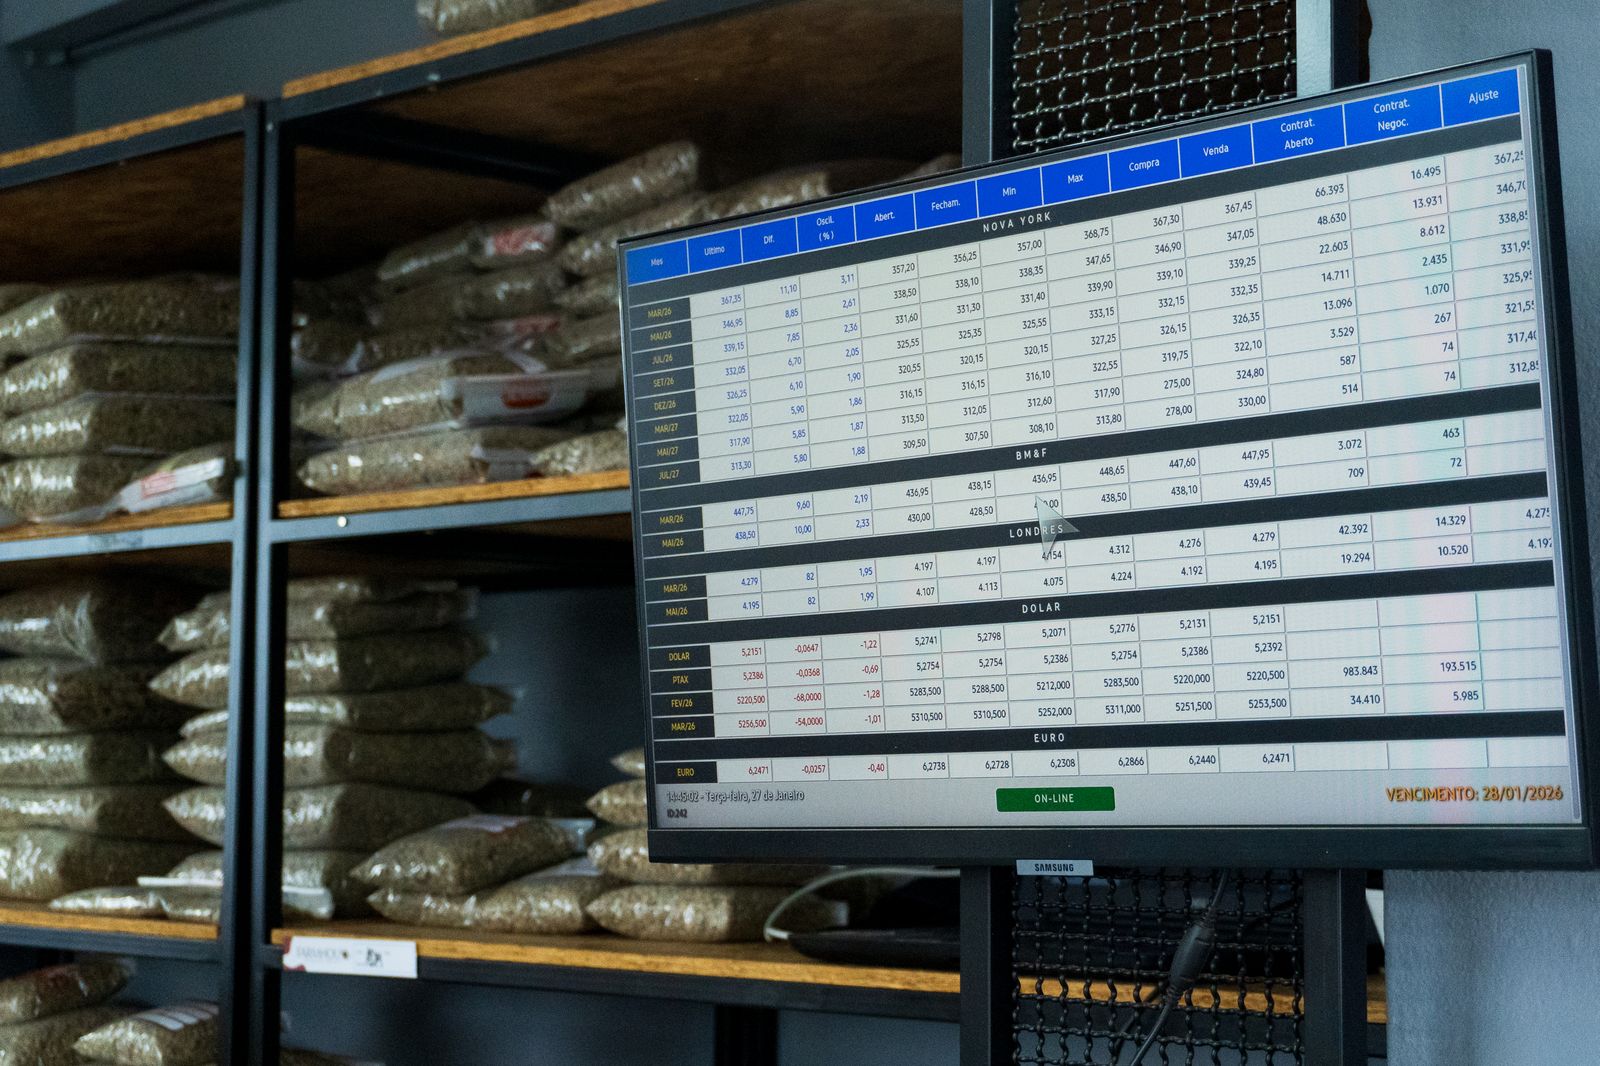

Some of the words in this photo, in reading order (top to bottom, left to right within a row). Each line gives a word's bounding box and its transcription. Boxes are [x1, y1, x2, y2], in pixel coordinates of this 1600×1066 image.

[1468, 89, 1499, 104] Ajuste
[1373, 98, 1410, 114] Contrat.
[1280, 118, 1315, 132] Contrat.
[1377, 118, 1409, 131] Negoc.
[1202, 144, 1229, 156] Venda
[1284, 136, 1314, 150] Aberto
[1128, 158, 1160, 172] Compra
[1067, 174, 1084, 184] Max
[1002, 186, 1017, 197] Min
[931, 199, 960, 211] Fecham.
[874, 211, 895, 222] Abert.
[982, 218, 1014, 232] NOVA
[1019, 211, 1051, 225] YORK
[647, 306, 672, 318] MAR/26
[720, 293, 742, 306] 367,35
[953, 250, 977, 263] 356,25
[1084, 226, 1109, 240] 368,75
[1152, 213, 1180, 227] 367,30
[1314, 183, 1345, 197] 66.393
[1411, 165, 1441, 179] 16.495
[763, 234, 774, 244] Dif.
[649, 330, 672, 341] MAI/26
[842, 297, 856, 309] 2,61
[893, 287, 917, 300] 338,50
[1018, 264, 1044, 278] 338,35
[1226, 227, 1254, 242] 347,05
[1412, 194, 1442, 209] 13.931
[652, 353, 673, 364] JUL/26
[723, 341, 744, 353] 339,15
[956, 302, 981, 314] 331,30
[1087, 279, 1113, 293] 339,90
[1156, 268, 1184, 281] 339,10
[1319, 240, 1348, 254] 22.603
[1419, 223, 1445, 237] 8.612
[652, 376, 674, 388] SET/26
[787, 356, 802, 367] 6,70
[896, 337, 920, 350] 325,55
[1022, 316, 1047, 330] 325,55
[1230, 283, 1258, 297] 332,35
[1422, 252, 1447, 267] 2.435
[653, 399, 676, 411] DEZ/26
[726, 388, 748, 400] 326,25
[959, 353, 984, 365] 320,15
[1090, 333, 1116, 346] 327,25
[1160, 322, 1187, 335] 326,15
[1323, 297, 1353, 310] 13.096
[1424, 282, 1450, 295] 1.070
[654, 422, 678, 433] MAR/27
[848, 396, 862, 407] 1,86
[900, 387, 923, 400] 316,15
[1025, 369, 1051, 382] 316,10
[1234, 339, 1263, 352] 322,10
[1434, 311, 1451, 324] 267
[656, 446, 679, 456] MAI/27
[729, 436, 750, 447] 317,90
[962, 404, 987, 416] 312,05
[1094, 386, 1121, 399] 317,90
[1163, 377, 1191, 390] 275,00
[1339, 354, 1356, 366] 587
[1441, 340, 1454, 352] 74
[658, 468, 680, 480] JUL/27
[793, 452, 808, 463] 5,80
[902, 438, 927, 450] 309,50
[1029, 421, 1054, 434] 308,10
[1238, 394, 1266, 408] 330,00
[1341, 383, 1358, 394] 514
[1443, 370, 1456, 382] 74
[1015, 447, 1046, 460] BM&F
[659, 514, 684, 524] MAR/26
[733, 506, 754, 516] 447,75
[967, 479, 992, 491] 438,15
[1099, 464, 1125, 476] 448,65
[1168, 457, 1197, 469] 447,60
[1241, 448, 1270, 460] 447,95
[1338, 438, 1362, 450] 3.072
[1442, 427, 1460, 439] 463
[661, 537, 684, 547] MAI/26
[855, 518, 870, 529] 2,33
[907, 511, 931, 523] 430,00
[1170, 484, 1198, 496] 438,10
[1243, 476, 1272, 488] 439,45
[1348, 466, 1364, 478] 709
[1450, 456, 1462, 468] 72
[1009, 524, 1064, 538] LONDRES
[663, 583, 688, 593] MAR/26
[740, 576, 758, 586] 4.279
[976, 555, 996, 566] 4.197
[1108, 544, 1130, 554] 4.312
[1178, 537, 1202, 548] 4.276
[1252, 531, 1276, 542] 4.279
[1338, 523, 1368, 535] 42.392
[1435, 514, 1466, 526] 14.329
[665, 606, 688, 616] MAI/26
[807, 596, 816, 606] 82
[915, 586, 935, 596] 4.107
[1043, 576, 1064, 586] 4.075
[1180, 565, 1203, 576] 4.192
[1254, 559, 1277, 570] 4.195
[1341, 551, 1370, 564] 19.294
[1437, 544, 1469, 556] 10.520
[1021, 601, 1060, 614] DOLAR
[668, 651, 690, 661] DOLAR
[741, 646, 762, 657] 5,2151
[977, 631, 1002, 642] 5,2798
[1109, 622, 1136, 634] 5,2776
[1179, 618, 1206, 630] 5,2131
[1252, 613, 1280, 626] 5,2151
[672, 675, 689, 684] PTAX
[861, 664, 879, 675] -0,69
[916, 660, 940, 672] 5,2754
[1043, 653, 1069, 664] 5,2386
[1181, 645, 1209, 657] 5,2386
[1254, 641, 1282, 653] 5,2392
[670, 698, 693, 708] FEV/26
[736, 695, 766, 705] 5220,500
[971, 683, 1005, 694] 5288,500
[1103, 676, 1140, 688] 5283,500
[1173, 673, 1211, 685] 5220,000
[1246, 669, 1285, 681] 5220,500
[1342, 664, 1378, 677] 983.843
[1440, 660, 1477, 672] 193.515
[671, 721, 696, 731] MAR/26
[794, 716, 824, 727] -54,0000
[911, 711, 943, 722] 5310,500
[1037, 706, 1072, 717] 5252,000
[1175, 700, 1213, 712] 5251,500
[1248, 697, 1287, 709] 5253,500
[1350, 694, 1381, 705] 34.410
[1452, 690, 1479, 701] 5.985
[1033, 732, 1065, 743] EURO
[676, 767, 695, 777] EURO
[748, 765, 769, 775] 6,2471
[984, 759, 1010, 770] 6,2728
[1118, 756, 1145, 768] 6,2866
[1188, 754, 1216, 766] 6,2440
[1262, 752, 1290, 764] 6,2471
[752, 789, 762, 801] 27
[763, 789, 774, 801] de
[775, 789, 805, 801] Janeiro
[1034, 793, 1075, 803] ON-LINE
[1386, 786, 1479, 802] VENCIMENTO:
[1482, 785, 1564, 803] 28/01/2026
[1034, 863, 1075, 872] SAMSUNG
